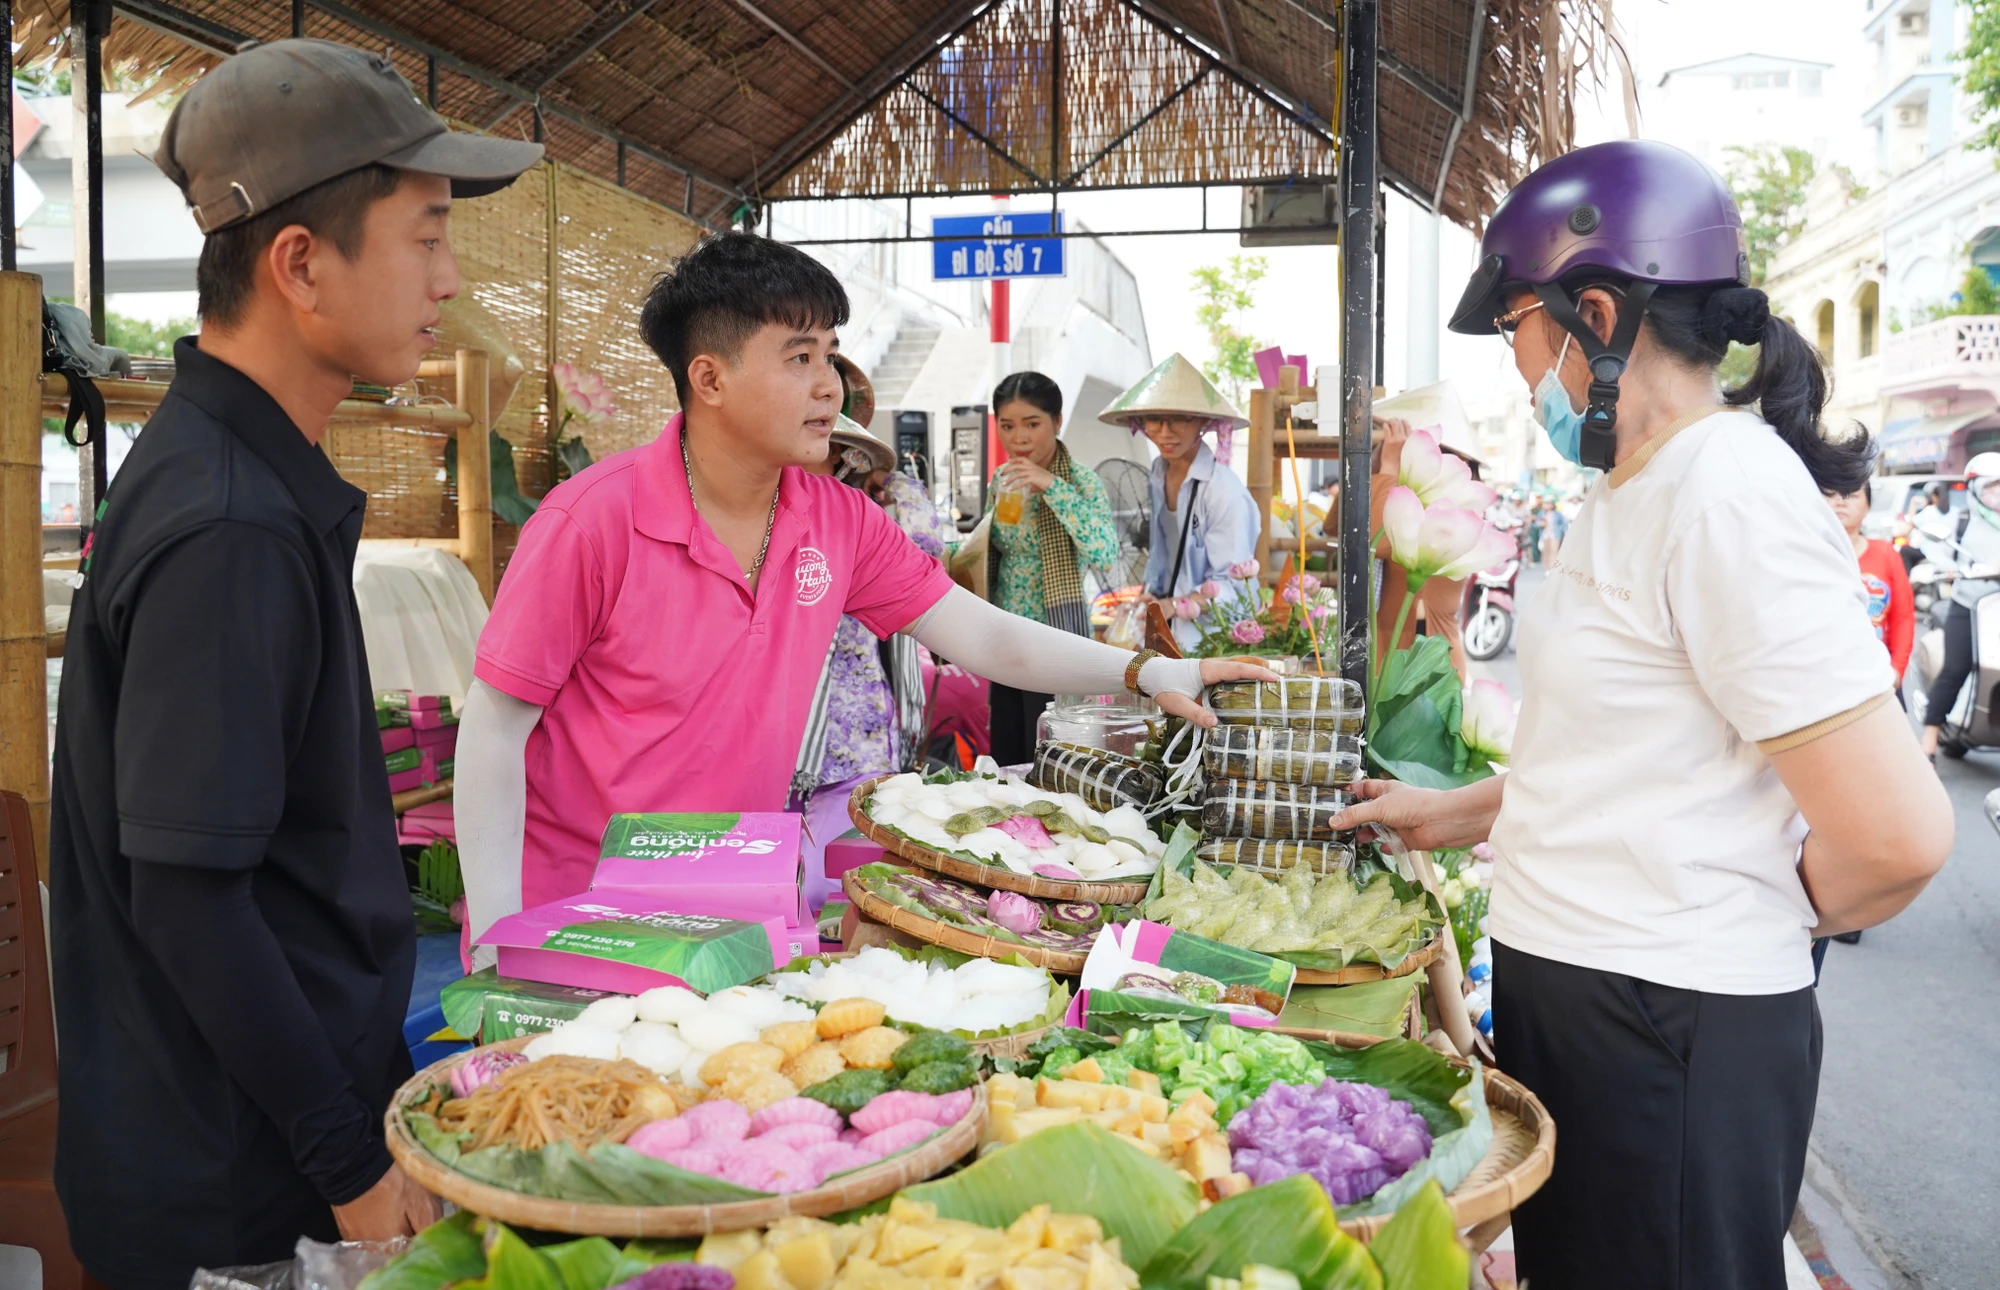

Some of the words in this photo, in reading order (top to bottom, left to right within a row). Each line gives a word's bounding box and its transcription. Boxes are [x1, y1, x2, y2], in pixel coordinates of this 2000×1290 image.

[1032, 247, 1042, 272] 7
[563, 932, 592, 941] 0977
[515, 1013, 543, 1027] 0977
[545, 1017, 566, 1028] 230
